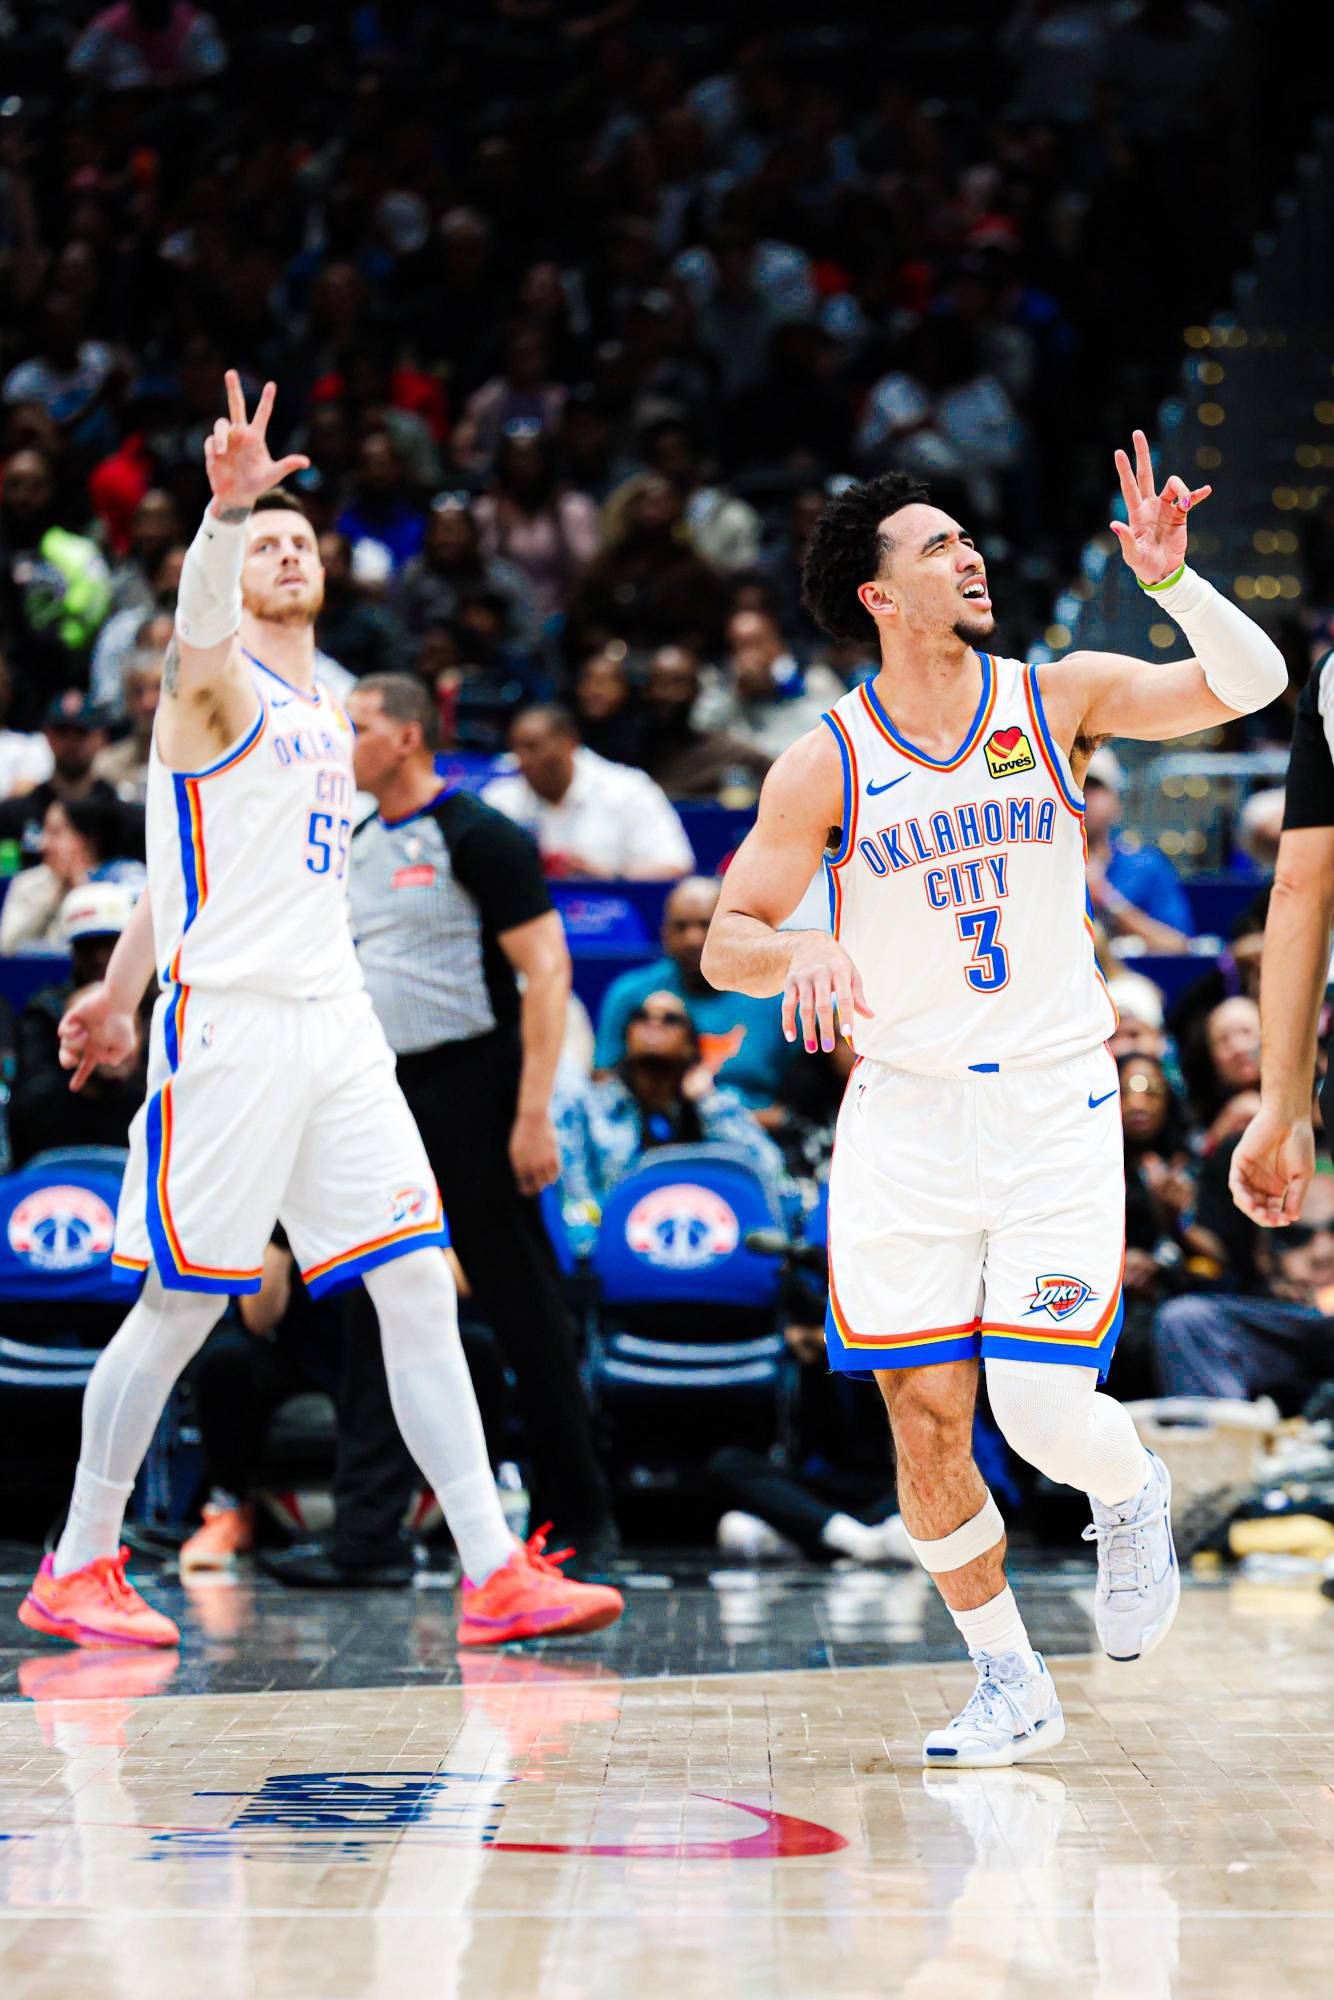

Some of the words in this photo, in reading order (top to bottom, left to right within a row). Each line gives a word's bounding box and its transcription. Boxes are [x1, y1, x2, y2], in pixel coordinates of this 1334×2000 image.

[857, 798, 1056, 878] OKLAHOMA
[924, 853, 1009, 910] CITY
[955, 906, 1010, 993] 3
